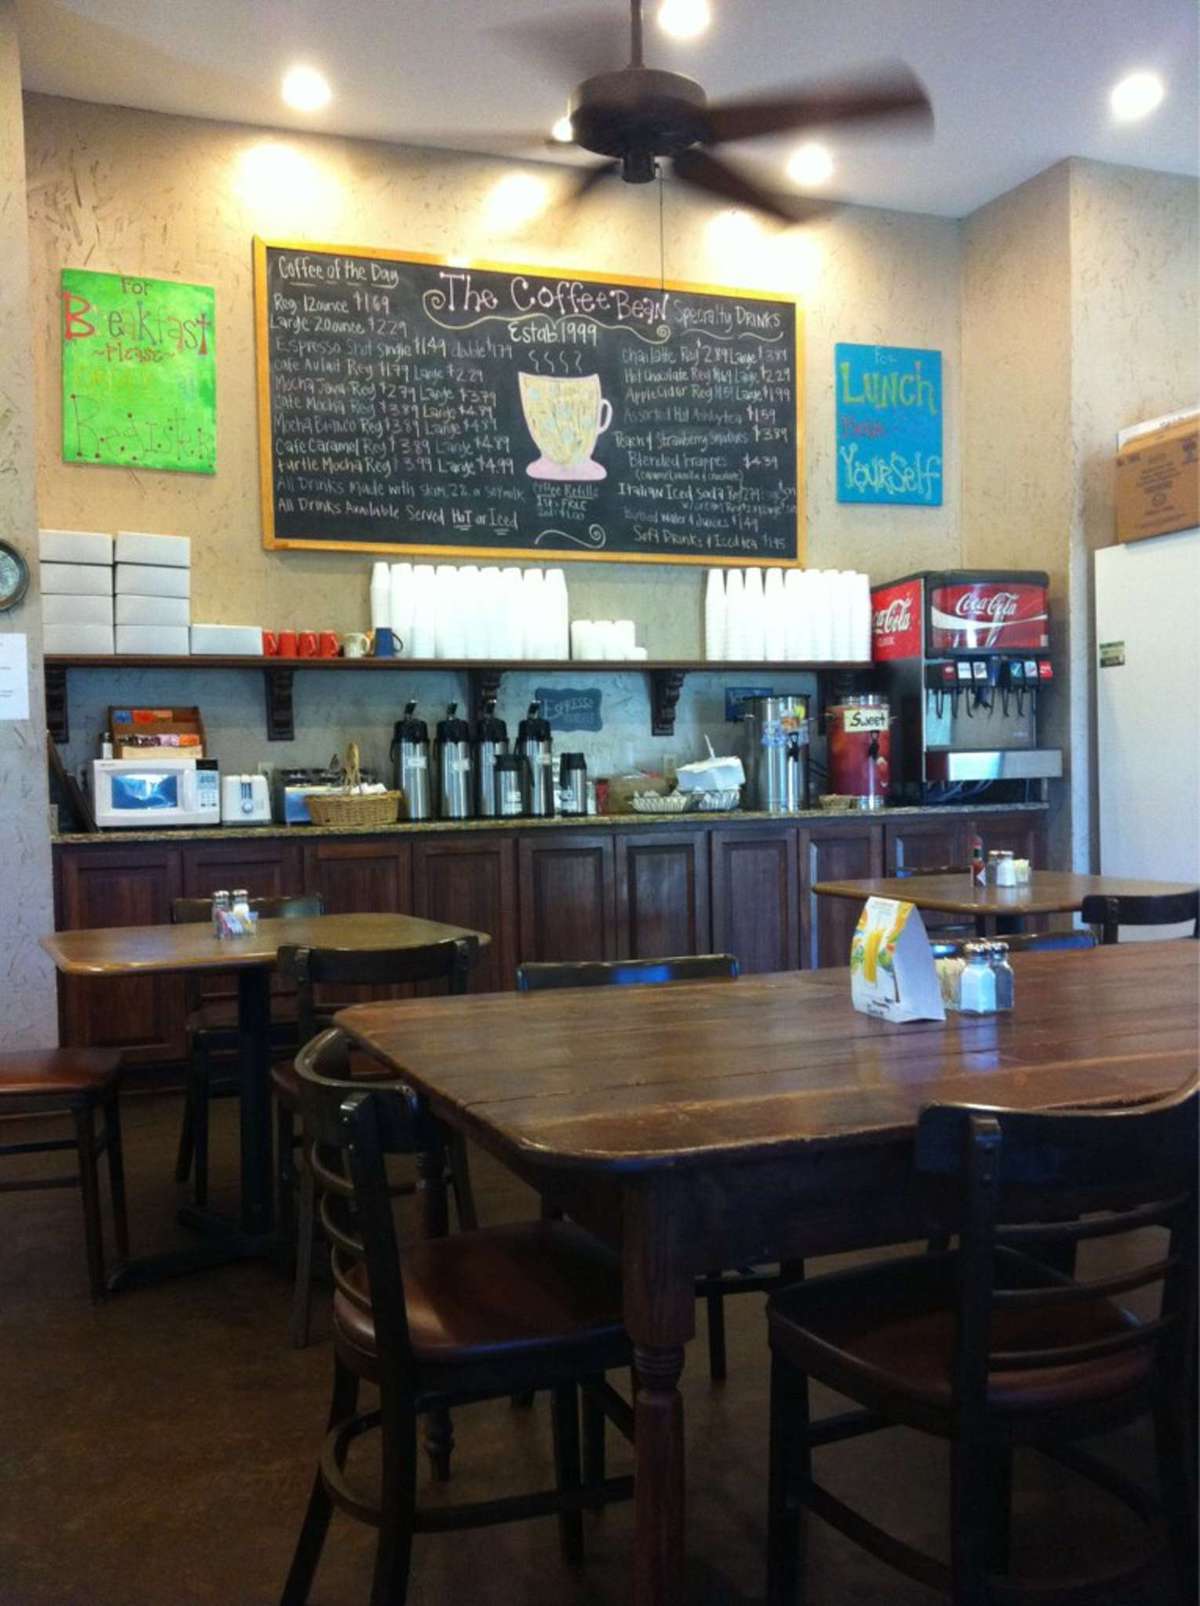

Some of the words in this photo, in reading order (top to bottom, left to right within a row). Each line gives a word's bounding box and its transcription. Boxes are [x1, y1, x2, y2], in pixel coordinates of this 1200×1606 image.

[278, 255, 324, 280] Coffee
[327, 258, 341, 280] of
[344, 258, 367, 281] the
[371, 262, 400, 288] Day
[273, 292, 297, 315] Reg
[439, 271, 498, 313] The
[510, 276, 611, 316] Coffee
[270, 313, 310, 334] Large
[561, 322, 598, 347] 1999
[275, 336, 342, 358] Espresso
[308, 437, 360, 457] Caramel
[321, 456, 363, 474] Mocha
[297, 476, 345, 495] Drinks
[278, 497, 295, 513] All
[297, 496, 342, 514] Drinks
[405, 504, 445, 526] Served
[475, 513, 487, 526] or
[488, 507, 519, 530] Iced
[850, 711, 886, 727] Sweet
